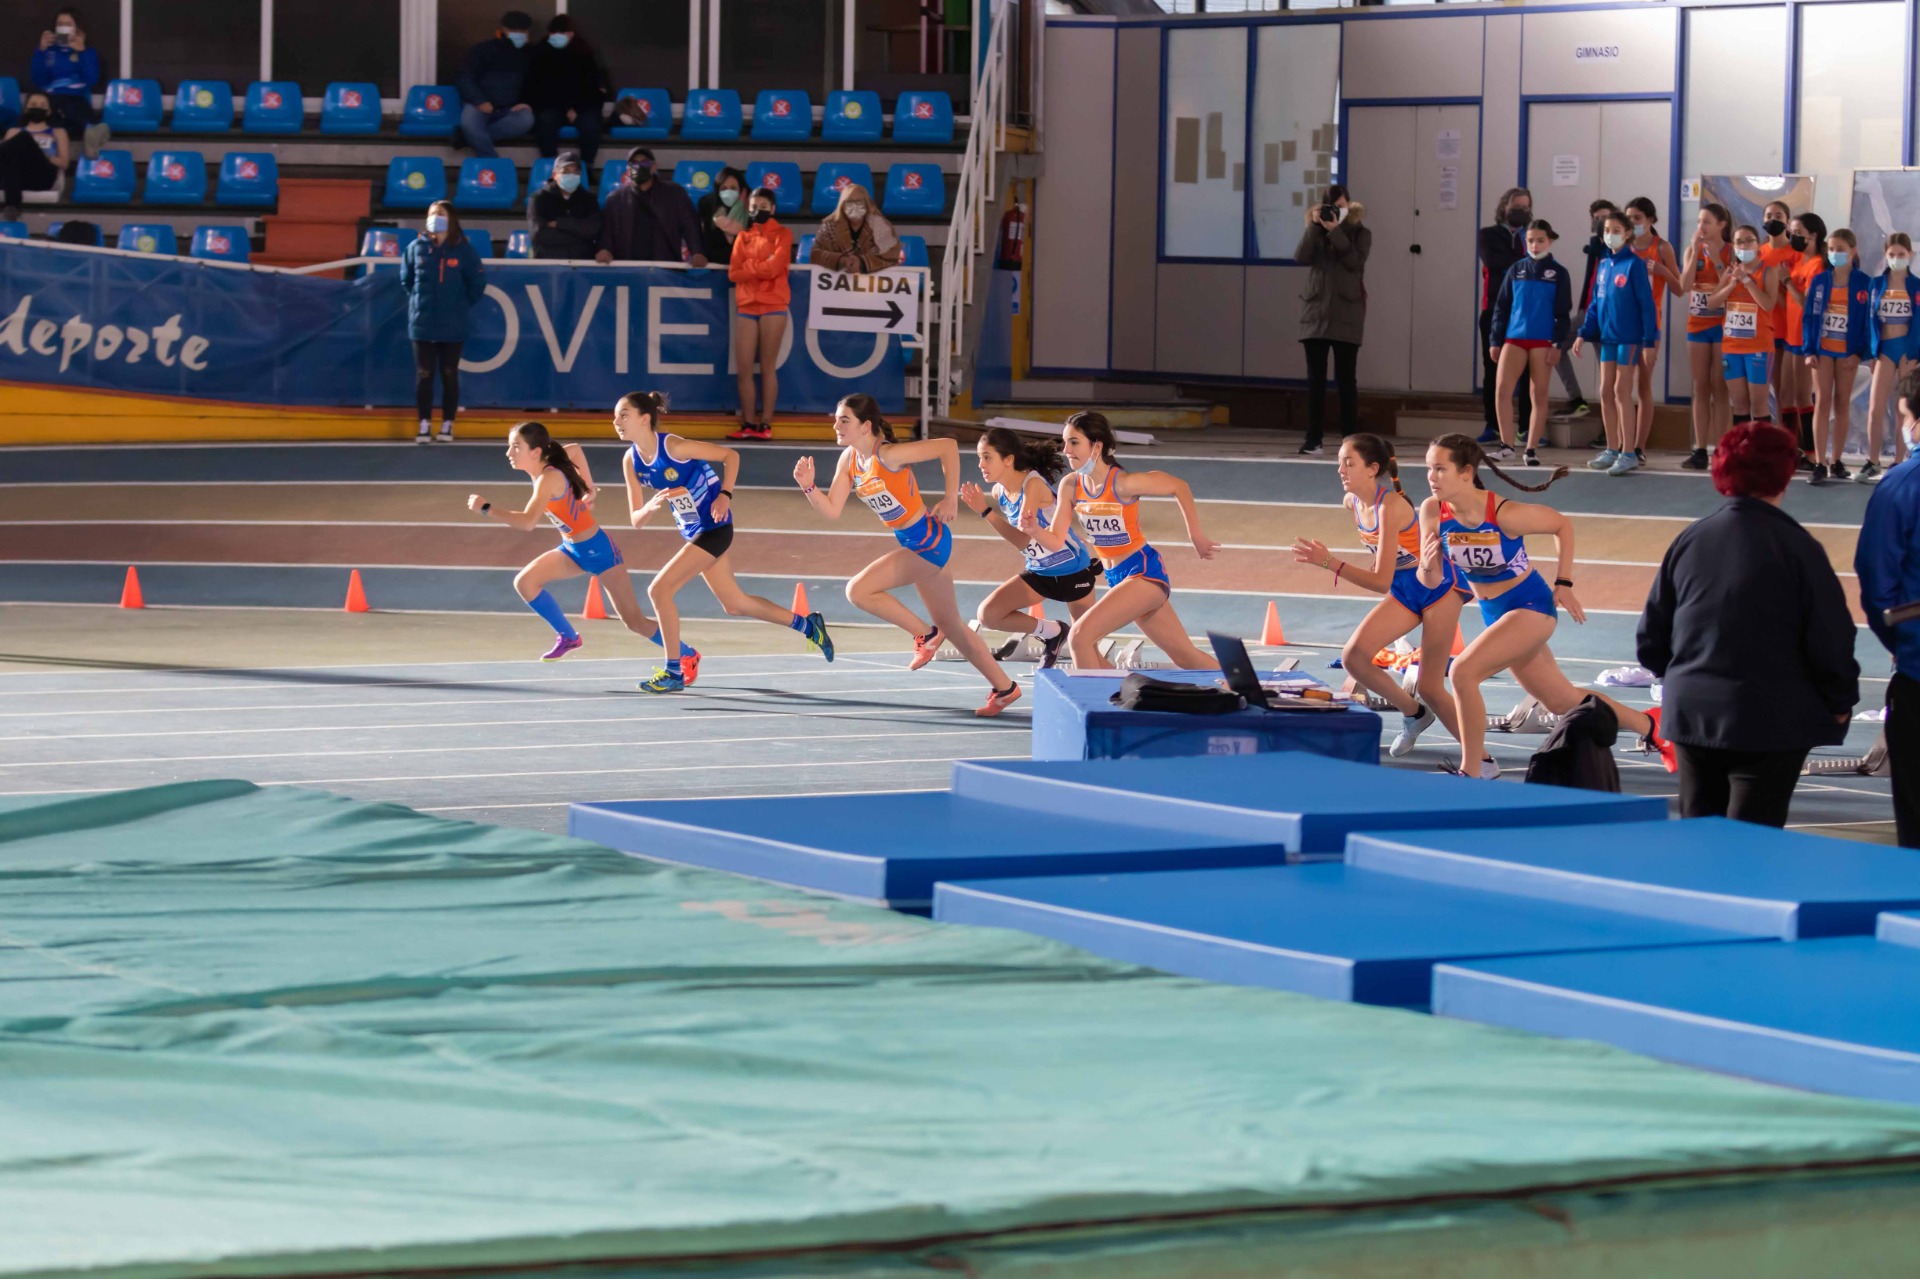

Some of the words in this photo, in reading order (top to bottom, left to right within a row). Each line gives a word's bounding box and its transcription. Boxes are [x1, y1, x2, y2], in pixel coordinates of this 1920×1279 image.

[1575, 46, 1619, 58] GIMNASIO
[817, 272, 912, 295] SALIDA
[1882, 301, 1911, 314] 4725
[1729, 314, 1753, 326] 4734
[0, 294, 209, 373] deporte
[868, 495, 893, 510] 4749
[1086, 518, 1121, 532] 4748
[1462, 547, 1496, 567] 152
